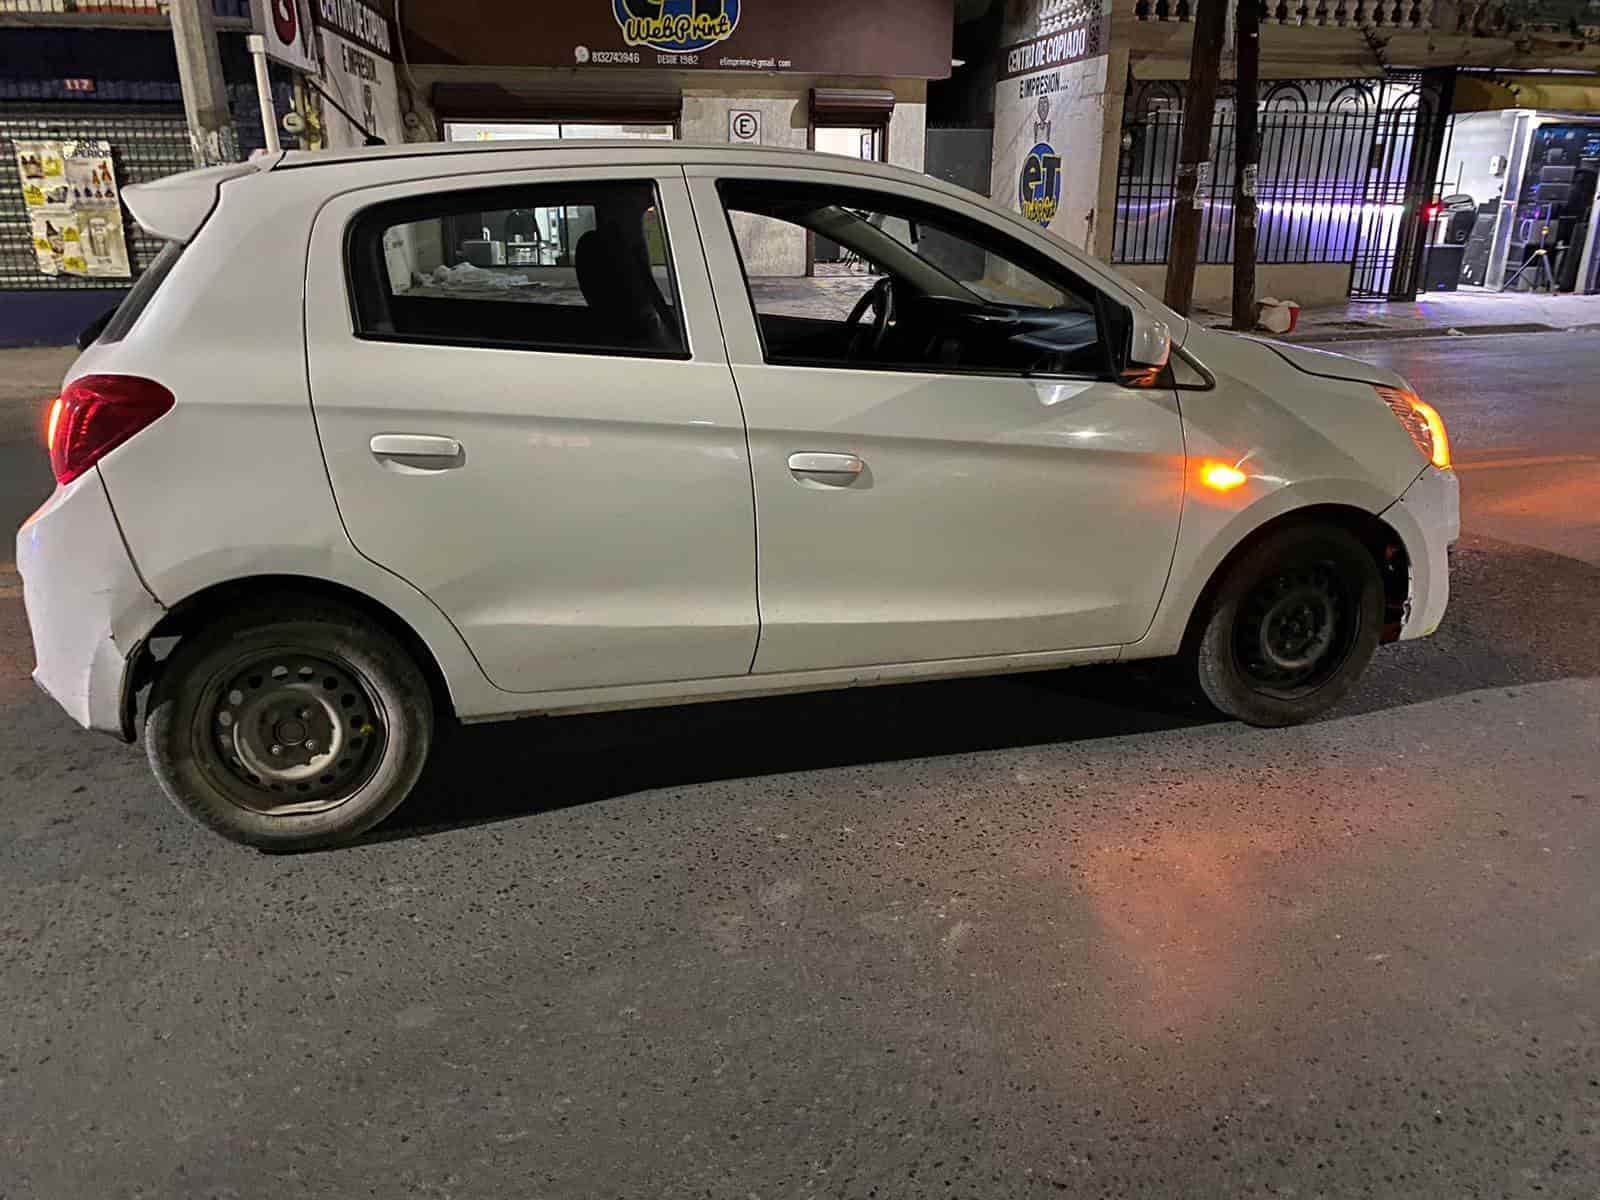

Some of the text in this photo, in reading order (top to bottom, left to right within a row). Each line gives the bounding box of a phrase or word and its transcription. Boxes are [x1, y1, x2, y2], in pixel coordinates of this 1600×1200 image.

[626, 15, 729, 41] WebPrint
[680, 55, 699, 65] 1982
[1008, 28, 1086, 72] CENTRO DE COPIADO
[739, 118, 751, 135] E
